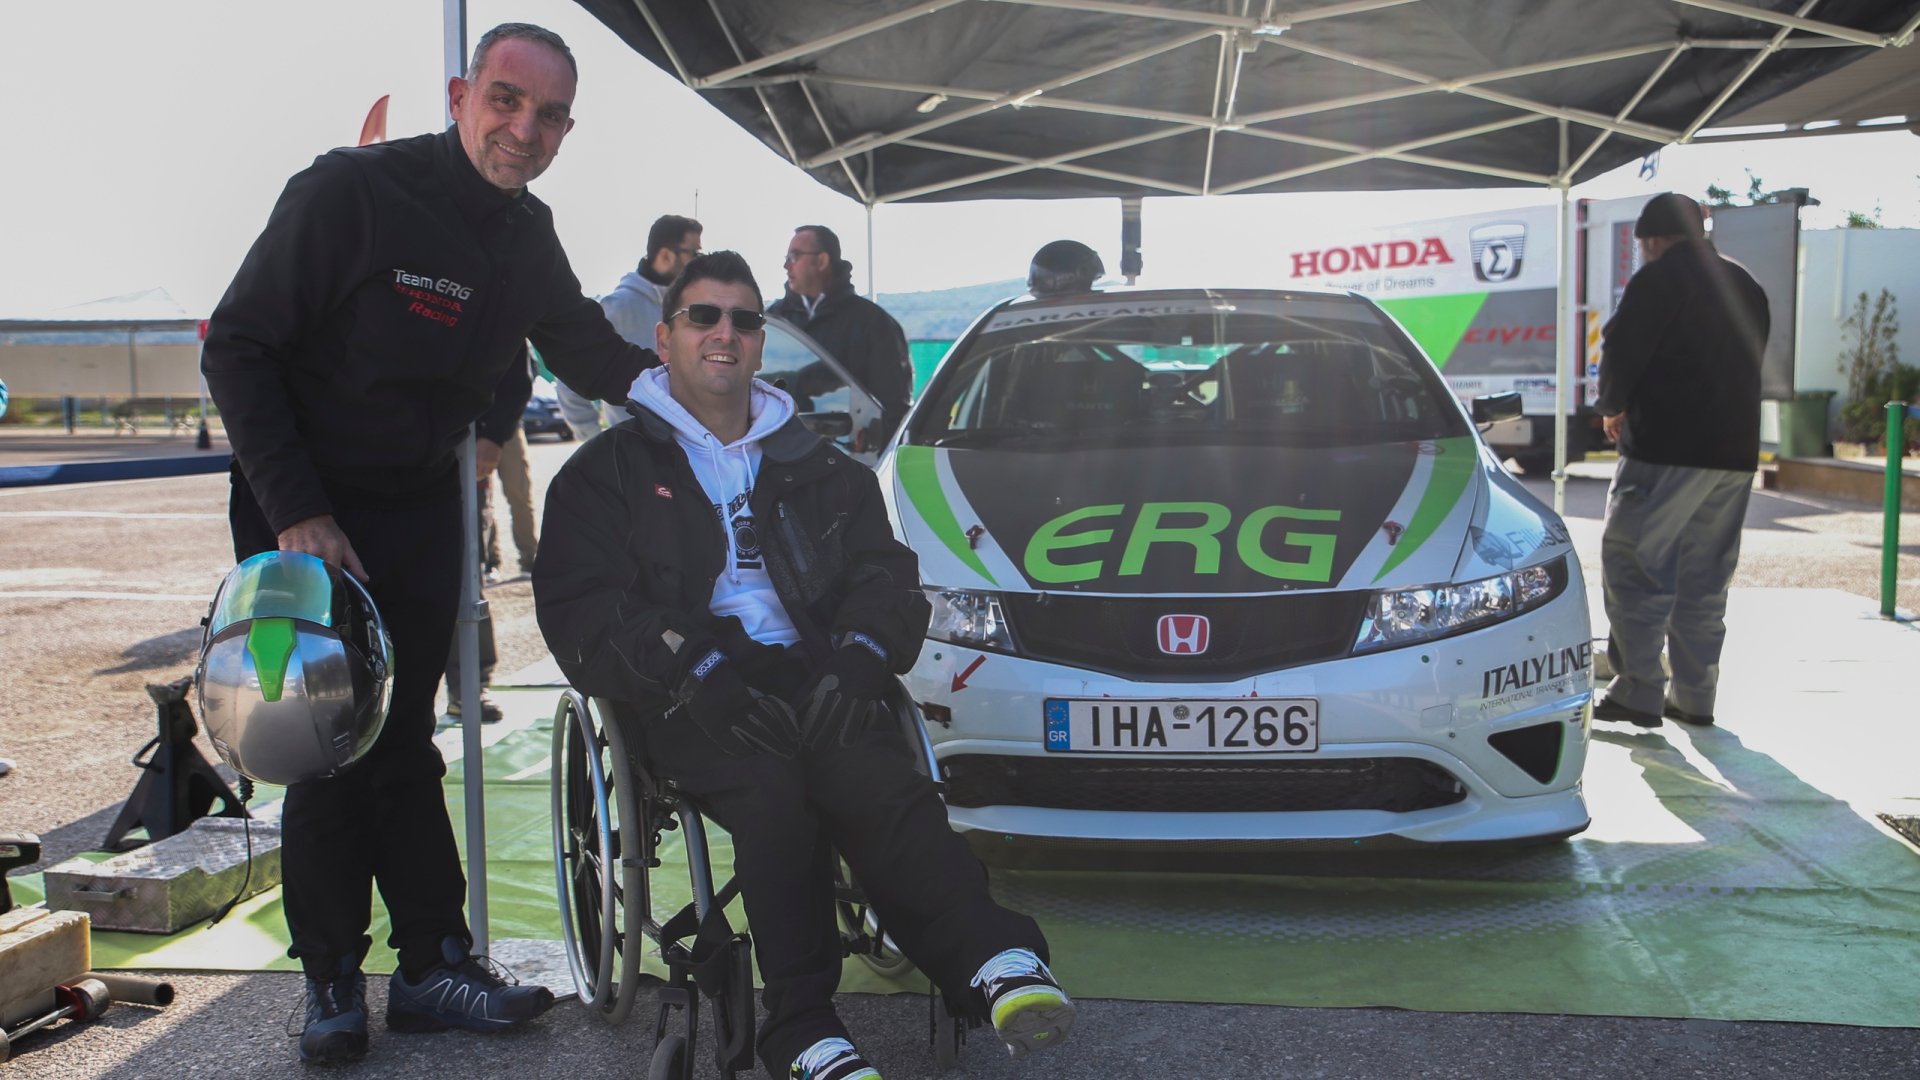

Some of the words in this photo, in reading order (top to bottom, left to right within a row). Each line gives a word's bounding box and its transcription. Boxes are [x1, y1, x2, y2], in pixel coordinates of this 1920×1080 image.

[1290, 236, 1455, 278] HONDA
[393, 268, 433, 290] Team
[435, 278, 474, 301] ERG
[1366, 279, 1380, 292] of
[1384, 276, 1435, 290] Dreams
[409, 289, 463, 312] HONDA
[409, 301, 459, 327] Racing
[992, 306, 1197, 329] SARACAKIS
[1464, 325, 1557, 346] CIVIC
[1024, 502, 1341, 584] ERG
[1480, 690, 1533, 711] INTERNATIONAL
[1049, 730, 1068, 742] GR
